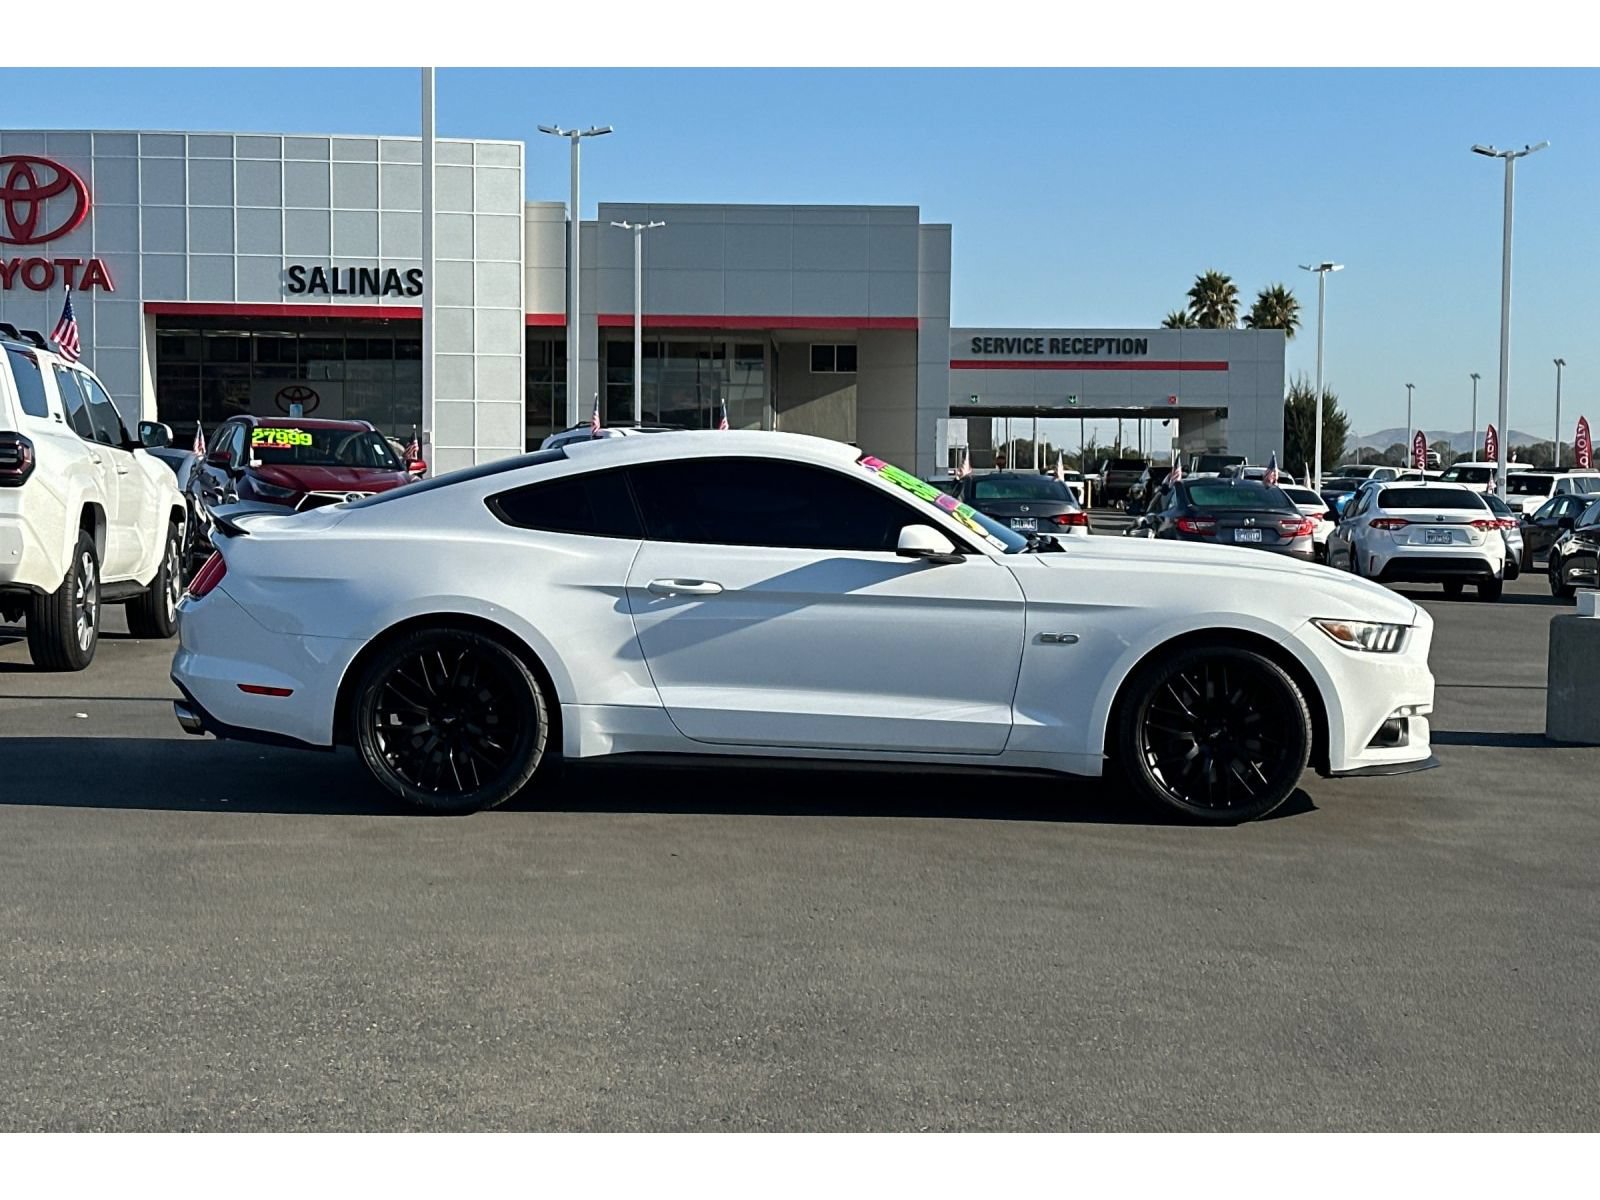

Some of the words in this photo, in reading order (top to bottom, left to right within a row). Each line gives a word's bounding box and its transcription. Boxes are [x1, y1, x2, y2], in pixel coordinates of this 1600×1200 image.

[288, 265, 423, 297] SALINAS
[971, 337, 1044, 355] SERVICE
[1049, 337, 1148, 355] RECEPTION
[252, 431, 312, 446] 27999
